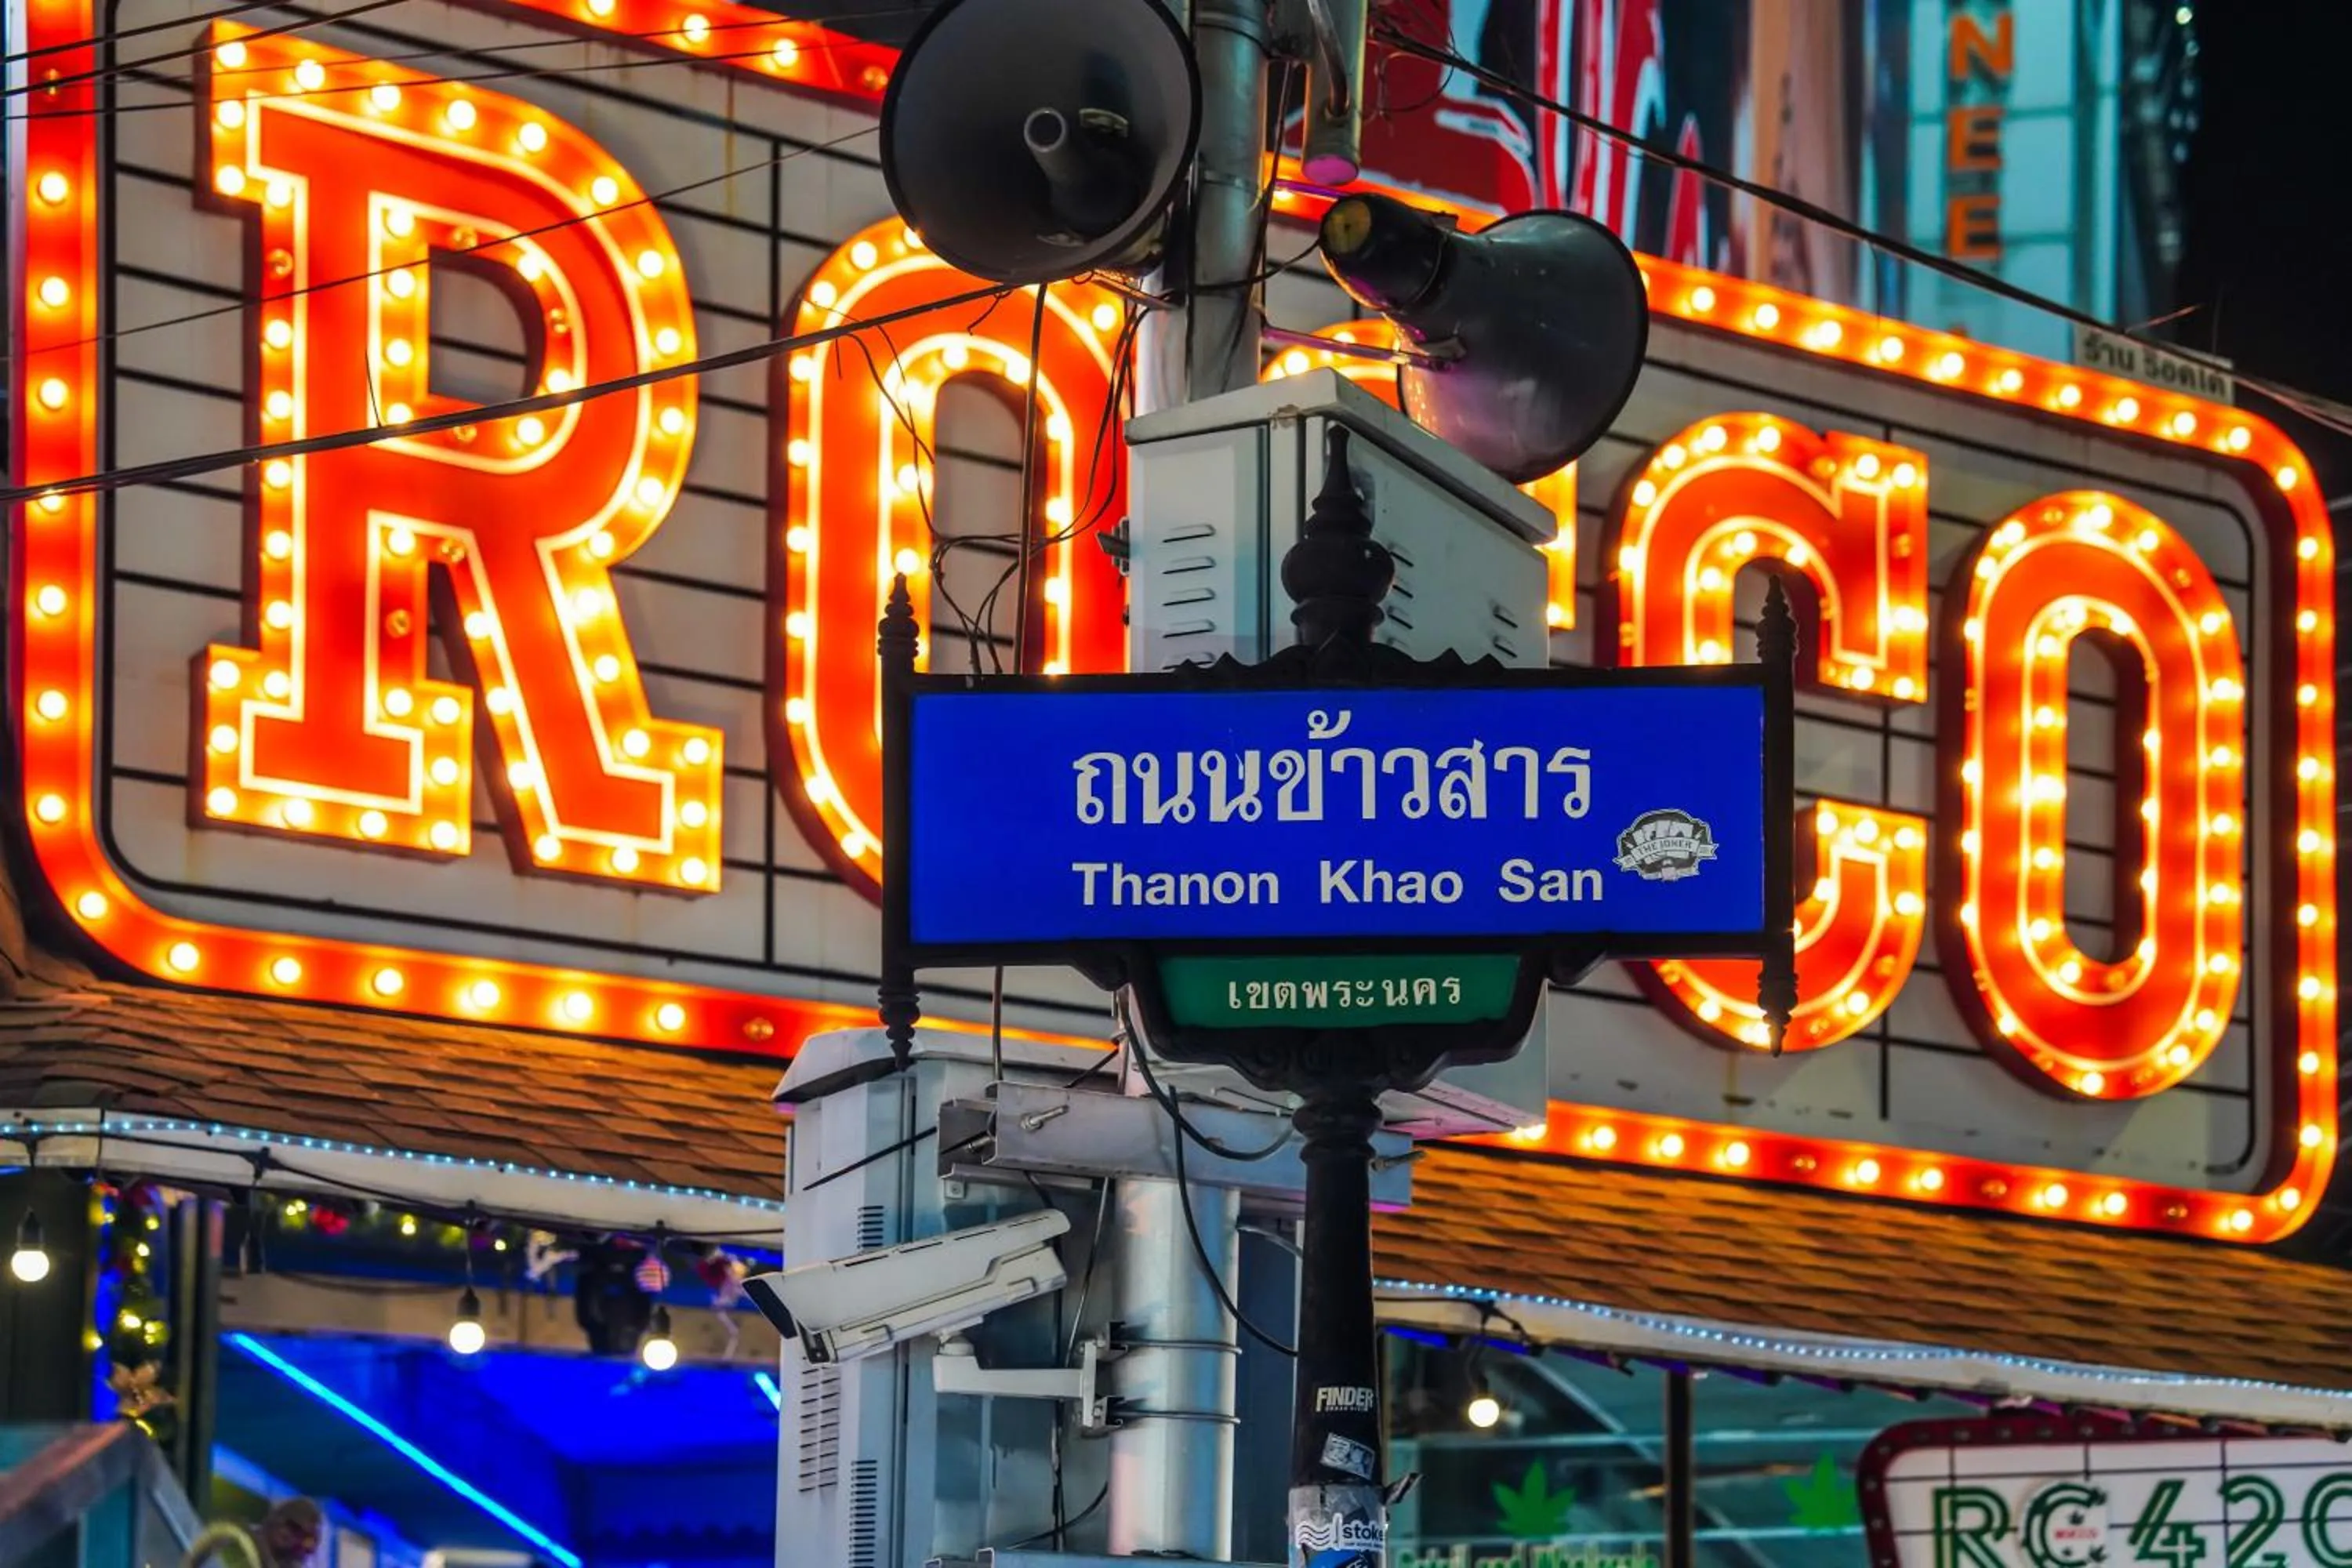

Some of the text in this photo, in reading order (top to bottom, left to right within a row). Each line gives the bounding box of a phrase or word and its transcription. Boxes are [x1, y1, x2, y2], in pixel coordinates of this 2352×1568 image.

[204, 17, 2244, 1100] ROCO
[1073, 710, 1591, 824] ถนนข้าวสาร
[1637, 841, 1657, 855] THE
[1072, 858, 1603, 906] Thanon Khao San
[1229, 977, 1461, 1009] เขตพระนคร
[1316, 1386, 1374, 1412] FINDER
